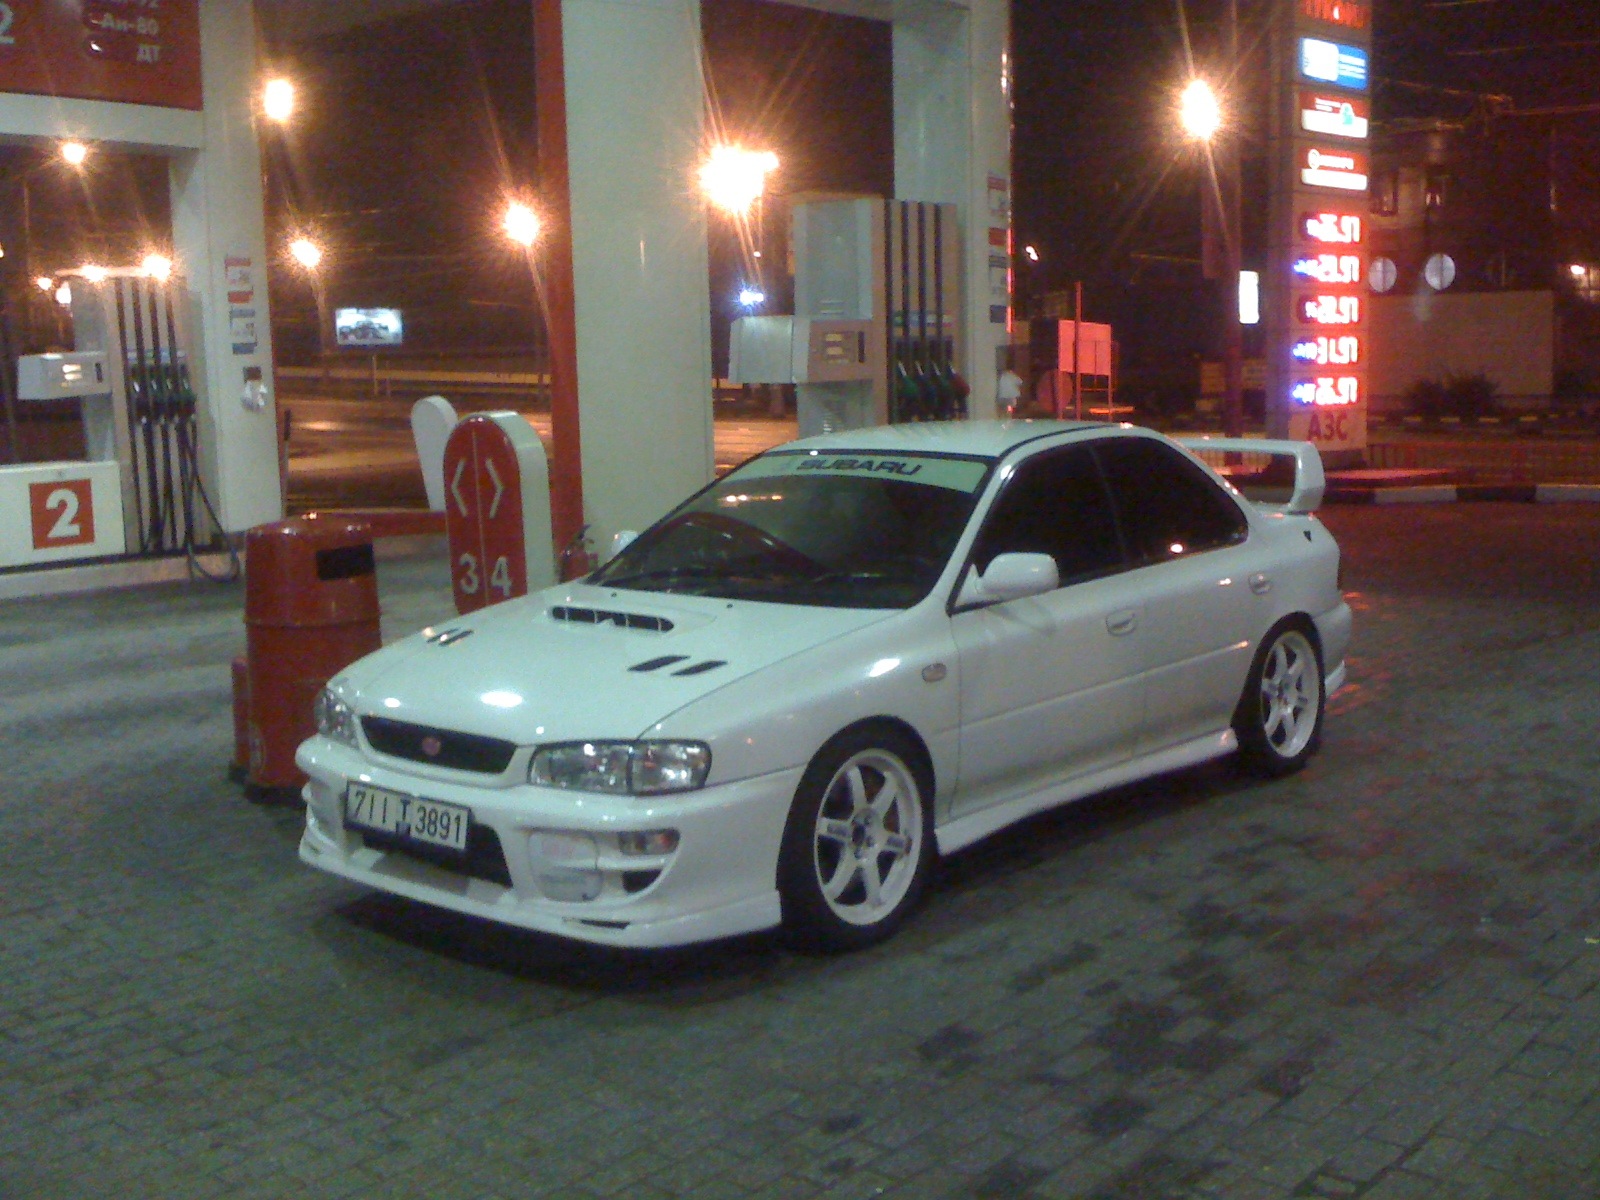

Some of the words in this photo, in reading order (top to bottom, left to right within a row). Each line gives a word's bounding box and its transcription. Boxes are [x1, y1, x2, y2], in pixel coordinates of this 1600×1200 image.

[797, 459, 923, 476] SUBARU
[45, 488, 81, 538] 2
[459, 553, 480, 594] 3
[491, 556, 512, 599] 4
